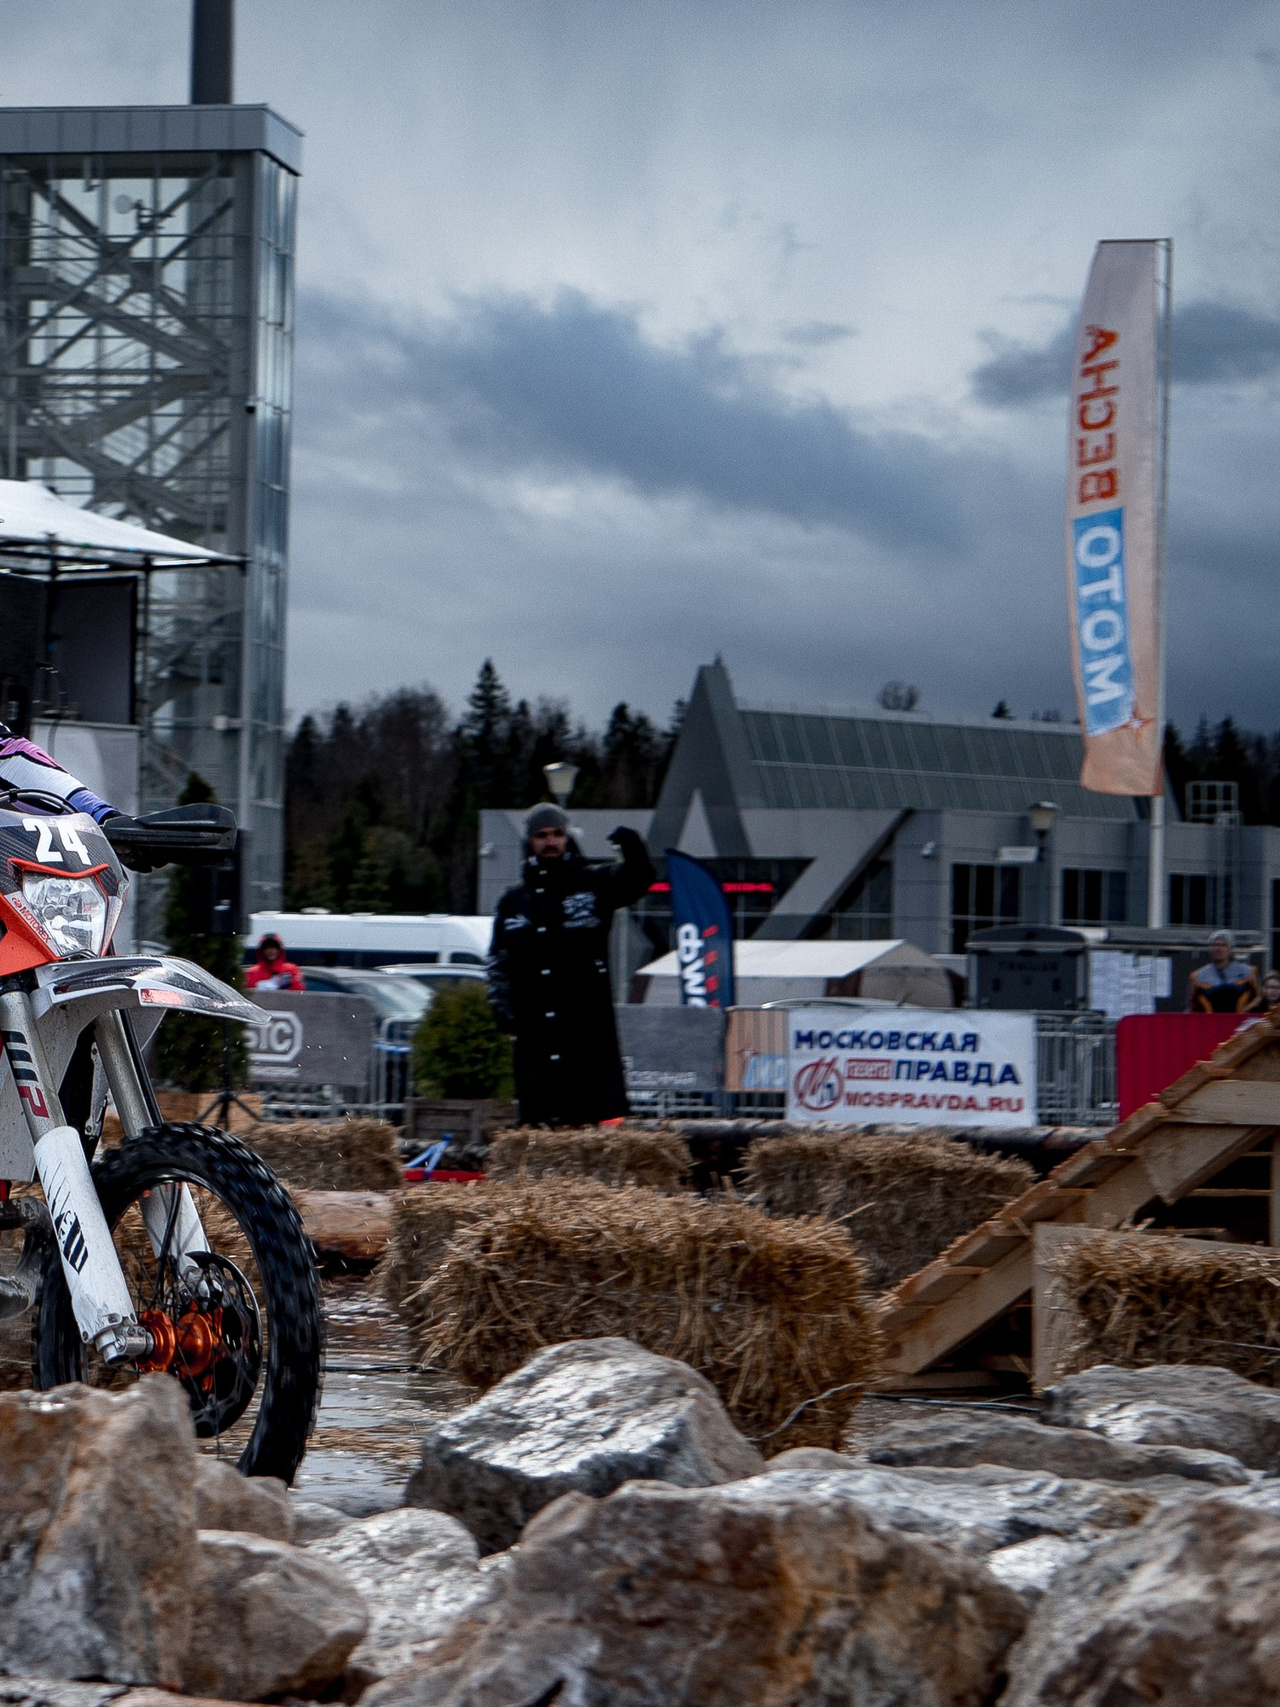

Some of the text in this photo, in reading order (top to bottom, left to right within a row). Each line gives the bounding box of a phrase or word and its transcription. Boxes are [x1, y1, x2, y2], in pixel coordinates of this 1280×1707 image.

[21, 817, 92, 866] 24
[19, 903, 51, 943] MOTOREX
[794, 1029, 980, 1053] МОСКОВСКАЯ
[894, 1058, 1022, 1087] ПРАВДА
[843, 1092, 1024, 1113] MOSPRAVDA.RU
